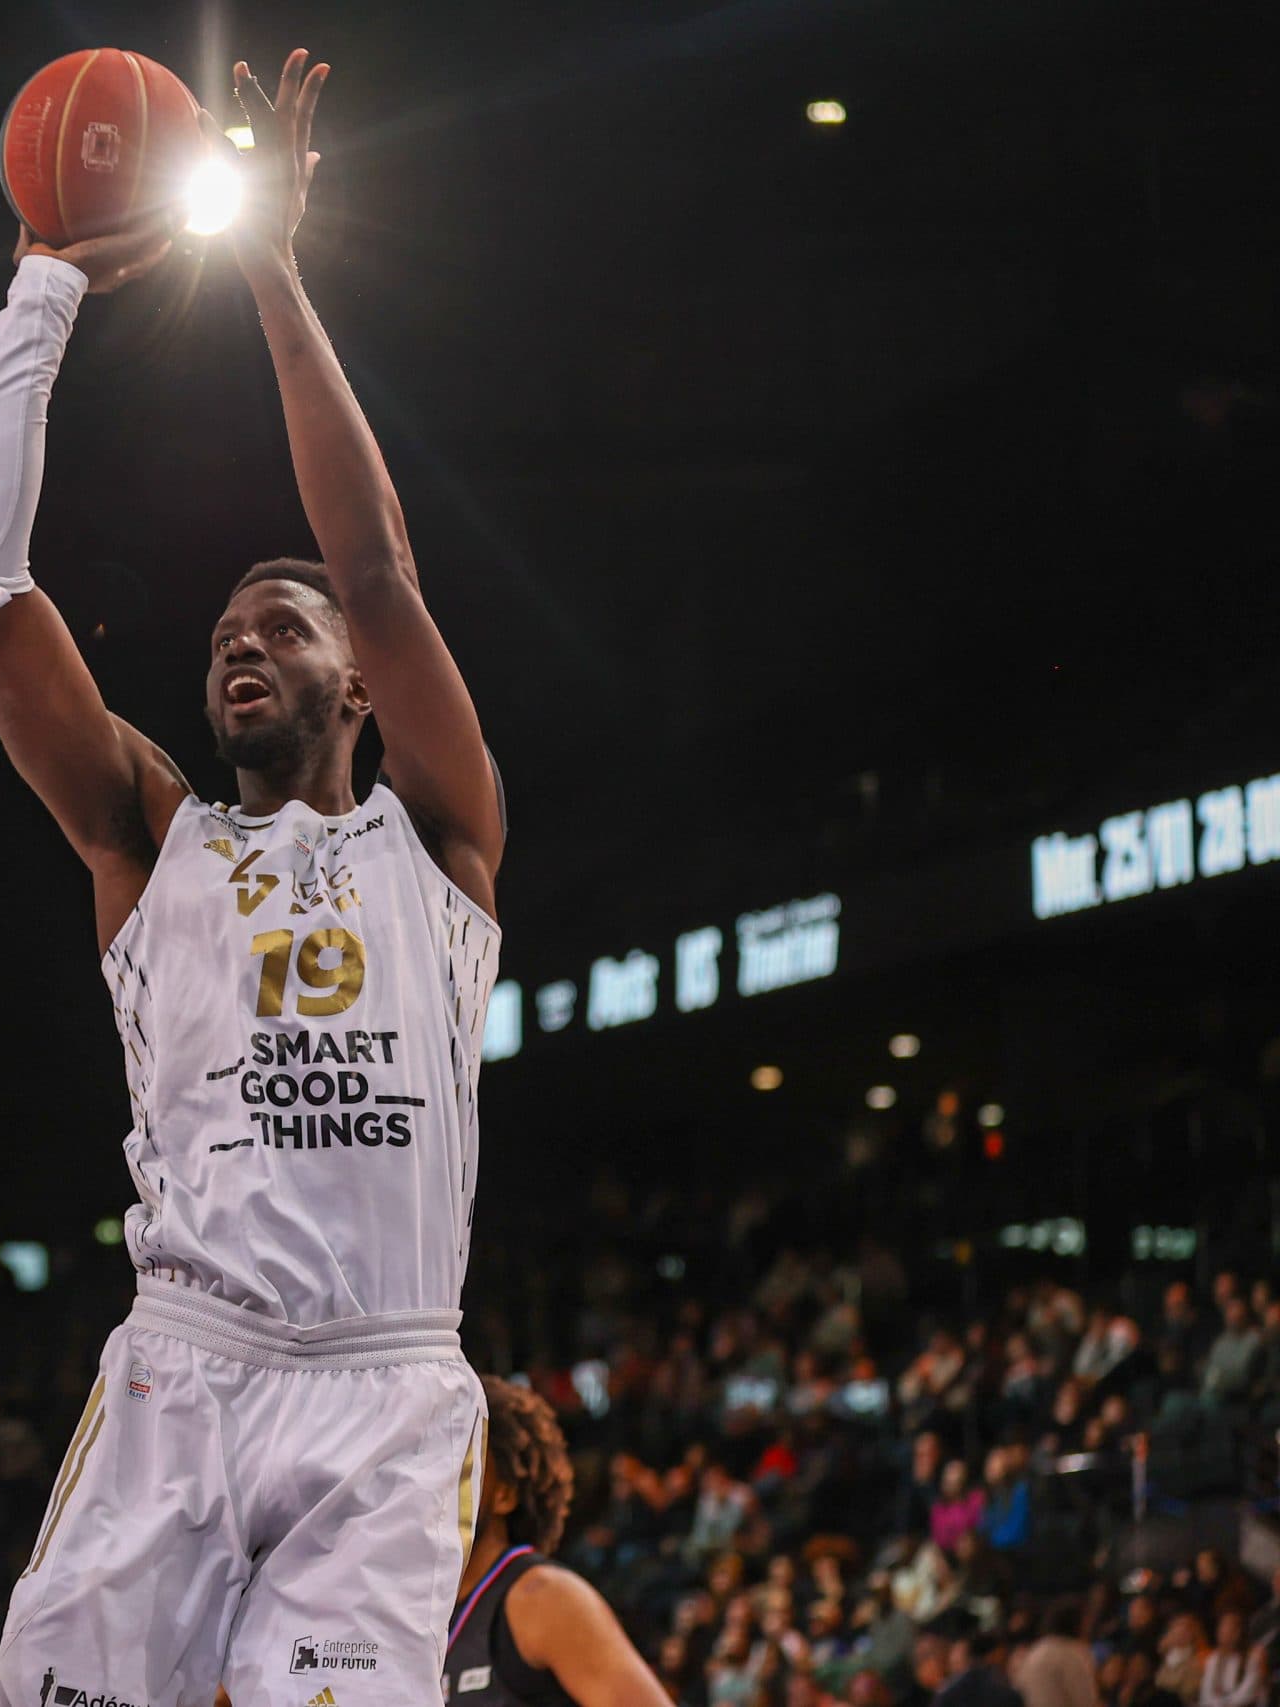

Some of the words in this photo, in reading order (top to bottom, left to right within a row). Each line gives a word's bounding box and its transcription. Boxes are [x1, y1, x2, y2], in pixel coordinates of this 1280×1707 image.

[250, 927, 367, 1018] 19
[250, 1029, 399, 1067] SMART
[240, 1070, 370, 1108] GOOD
[249, 1110, 412, 1149] THINGS
[322, 1656, 338, 1669] DU
[341, 1658, 377, 1671] FUTUR
[323, 1639, 379, 1657] Entreprise
